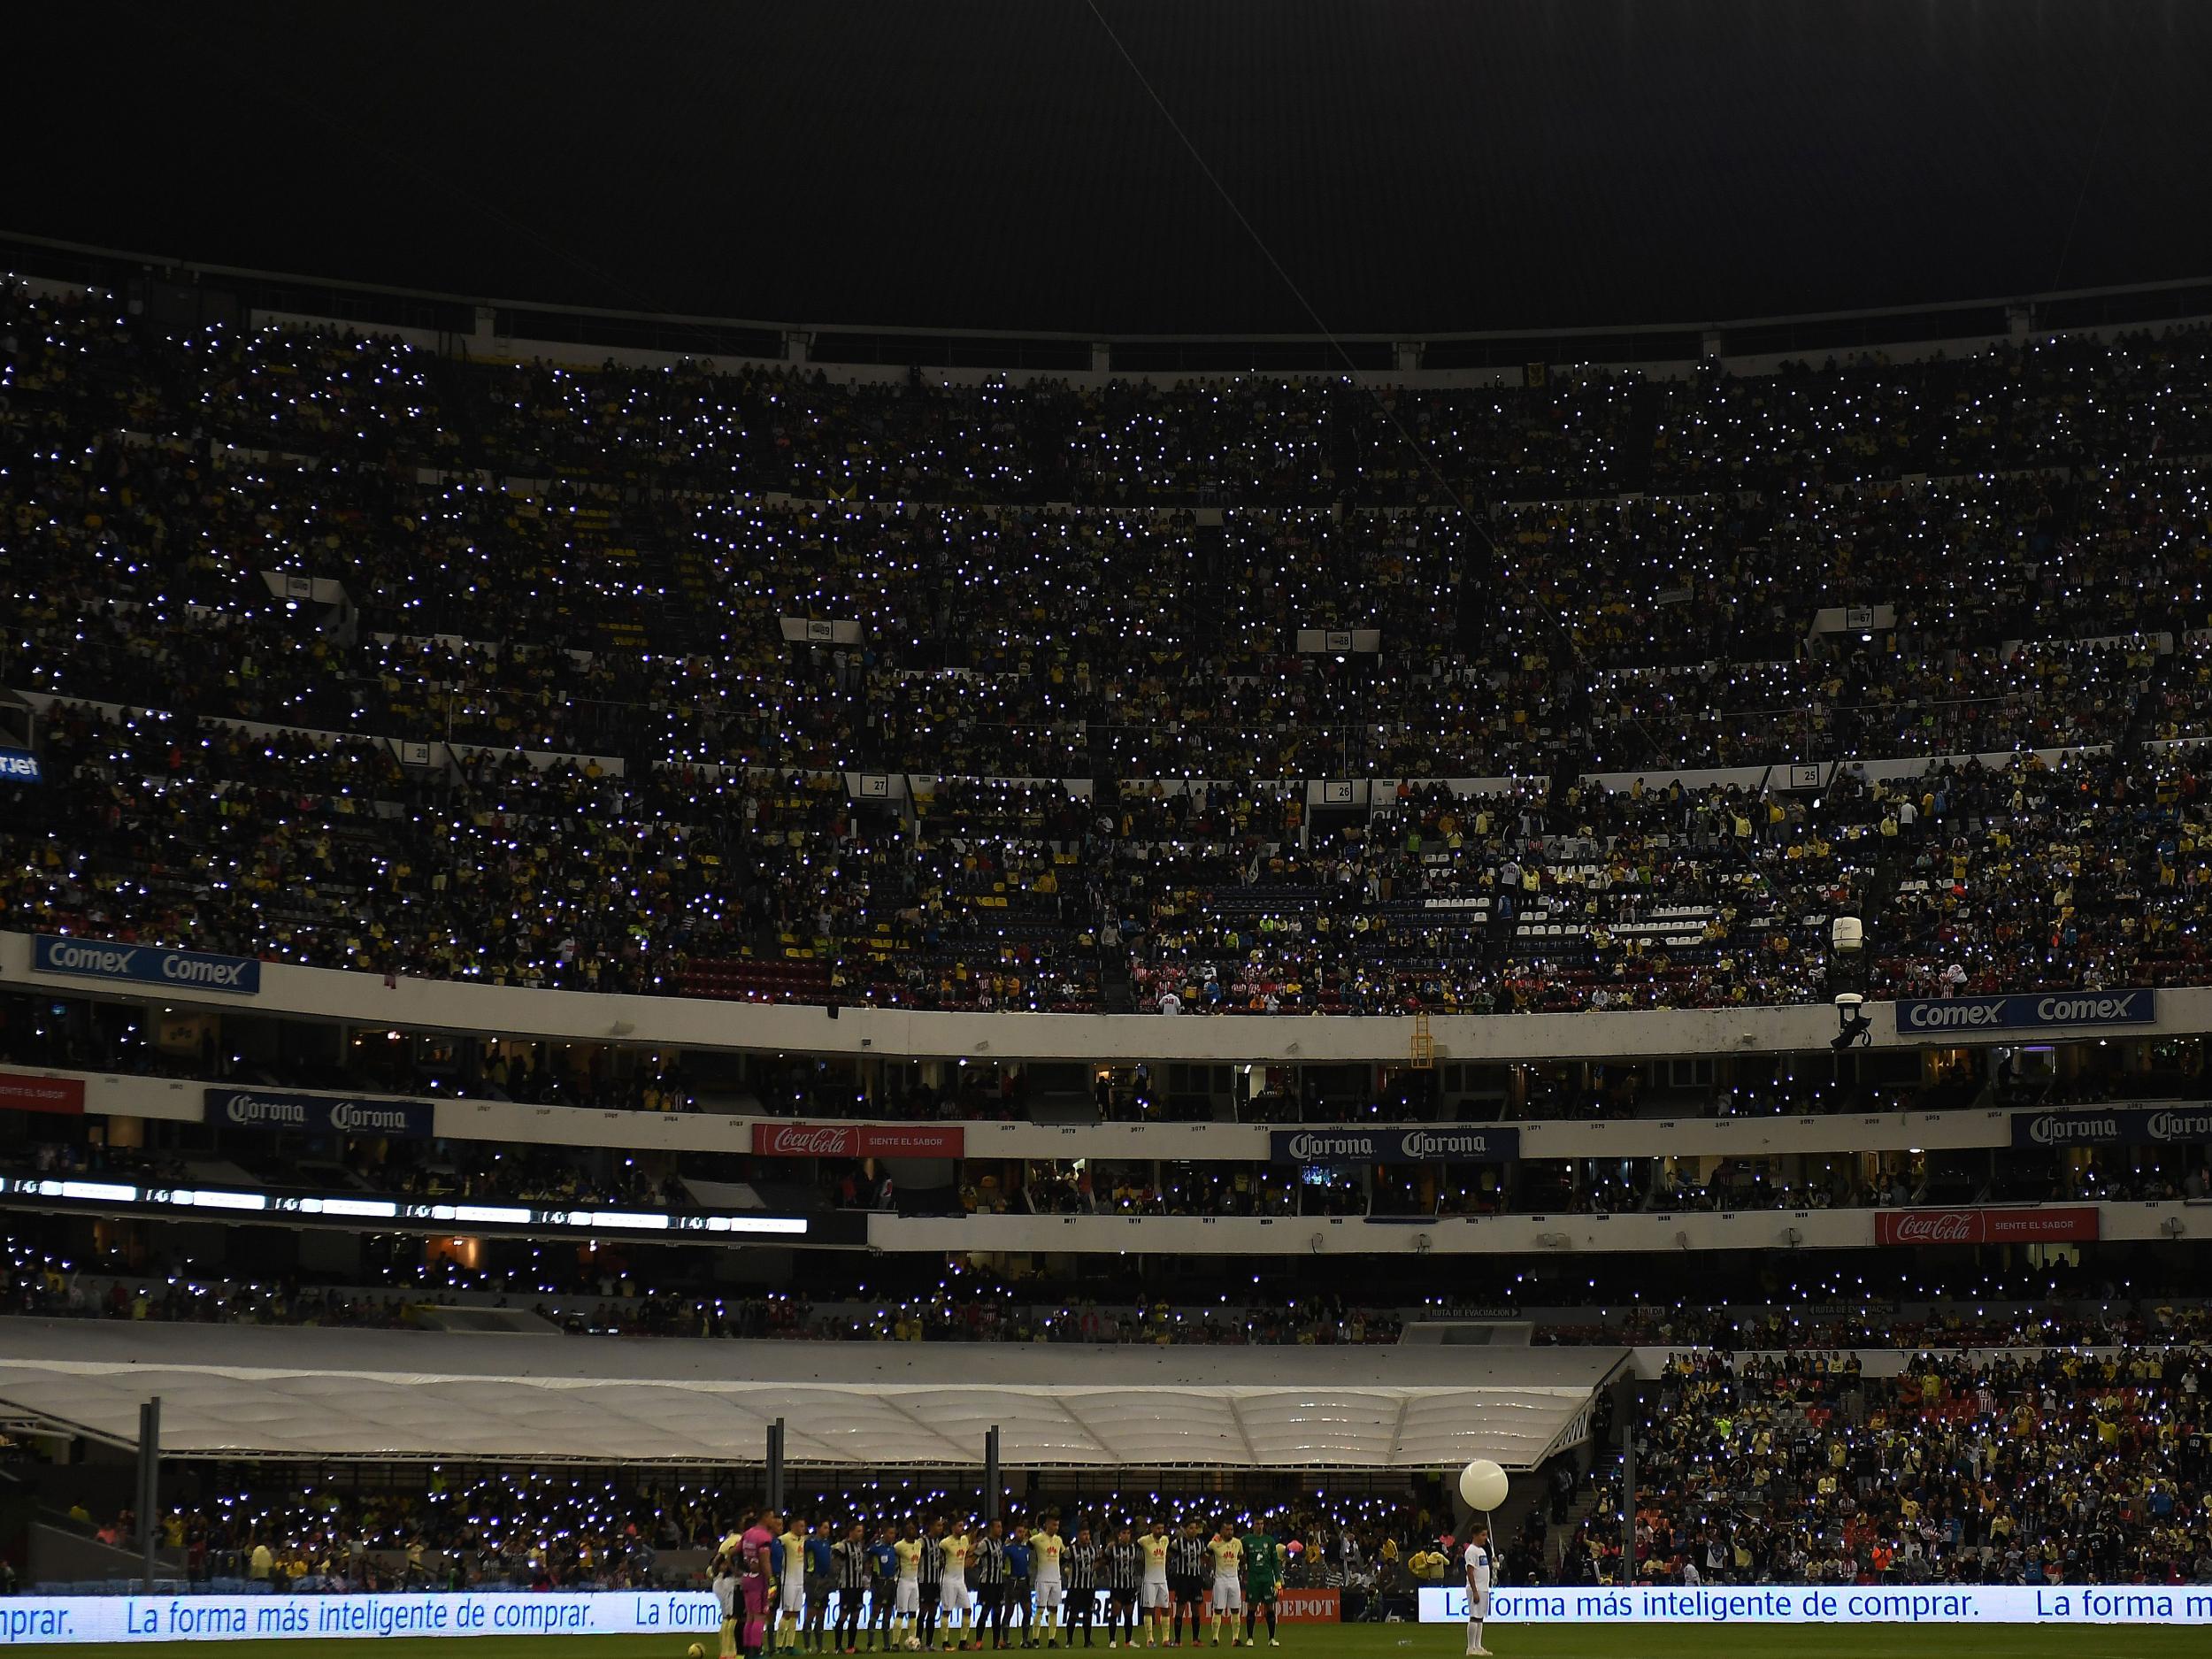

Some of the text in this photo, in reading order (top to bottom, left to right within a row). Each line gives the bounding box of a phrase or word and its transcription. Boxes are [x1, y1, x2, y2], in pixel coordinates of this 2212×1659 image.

[874, 780, 885, 790] 27
[1804, 771, 1816, 781] 25
[1339, 787, 1349, 797] 26
[49, 942, 247, 985] Comex Comex
[1909, 993, 2137, 1026] Comex Comex
[227, 1094, 407, 1133] Corona Corona
[869, 1137, 899, 1146] SIENTE
[901, 1137, 911, 1146] EL
[913, 1137, 942, 1147] SABOR
[2030, 1116, 2117, 1146] Corona
[1288, 1131, 1486, 1162] Corona Corona
[1994, 1221, 2028, 1230] SIENTE
[2029, 1221, 2040, 1230] EL
[2041, 1220, 2074, 1230] SABOR
[1815, 1305, 1835, 1314] RUTA
[127, 1597, 595, 1635] La forma más inteligente de comprar.
[635, 1596, 659, 1625] La
[1488, 1590, 1565, 1617] forma
[1578, 1590, 1632, 1617] más
[1644, 1590, 1791, 1621] inteligente
[1802, 1590, 1838, 1616] de
[1848, 1594, 1979, 1621] comprar.
[2037, 1590, 2070, 1616] La
[2082, 1590, 2172, 1616] forma
